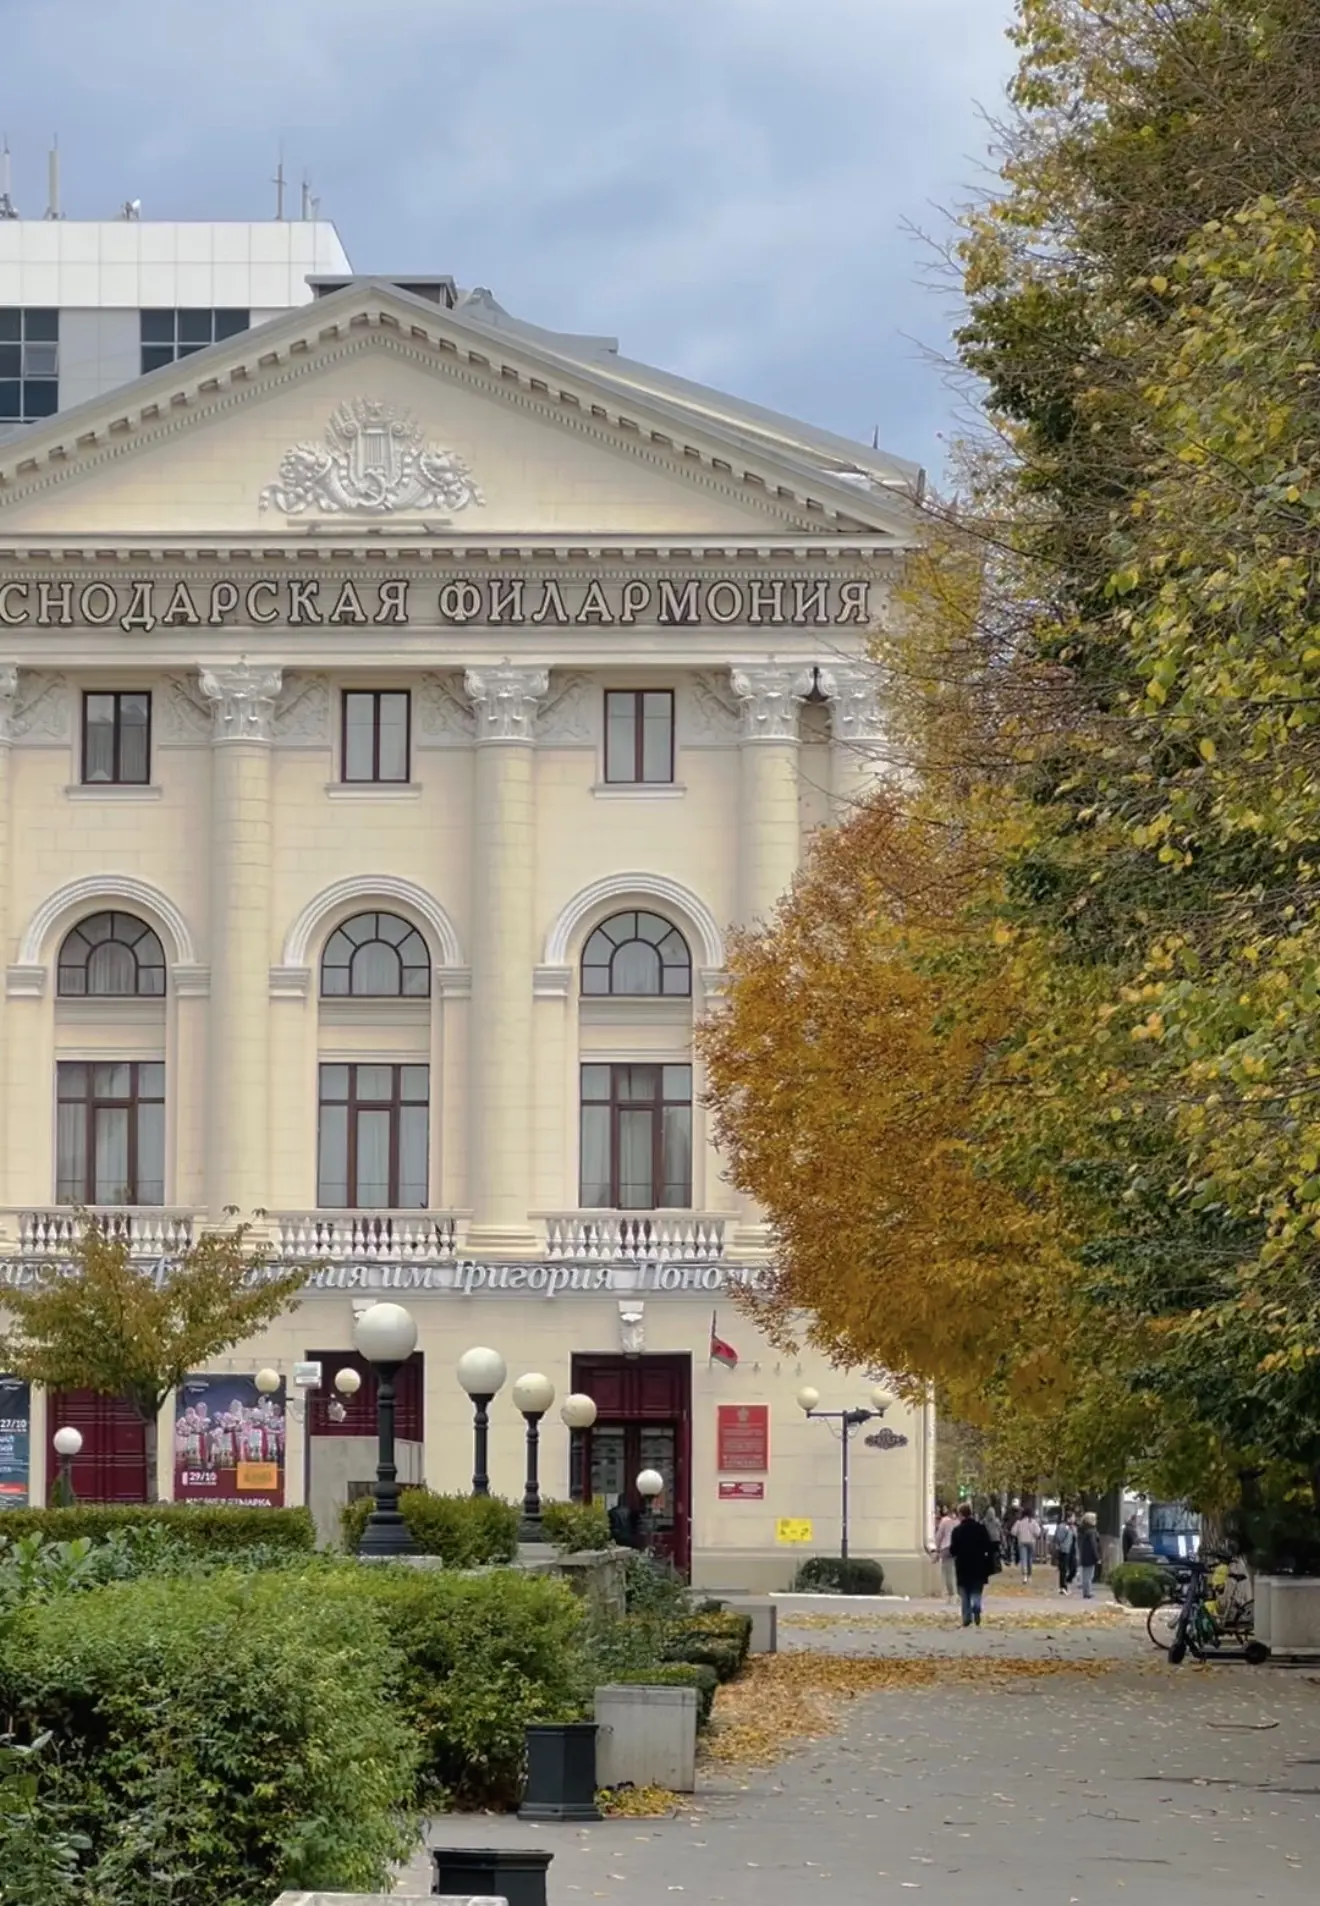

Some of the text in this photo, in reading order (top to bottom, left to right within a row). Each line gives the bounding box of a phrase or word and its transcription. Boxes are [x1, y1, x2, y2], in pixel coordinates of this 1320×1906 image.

[0, 578, 871, 632] СНОДАРСКАЯ ФИЛАРМОНИЯ
[453, 1259, 614, 1297] Григория
[0, 1419, 27, 1428] 27/10
[189, 1471, 218, 1481] 29/10
